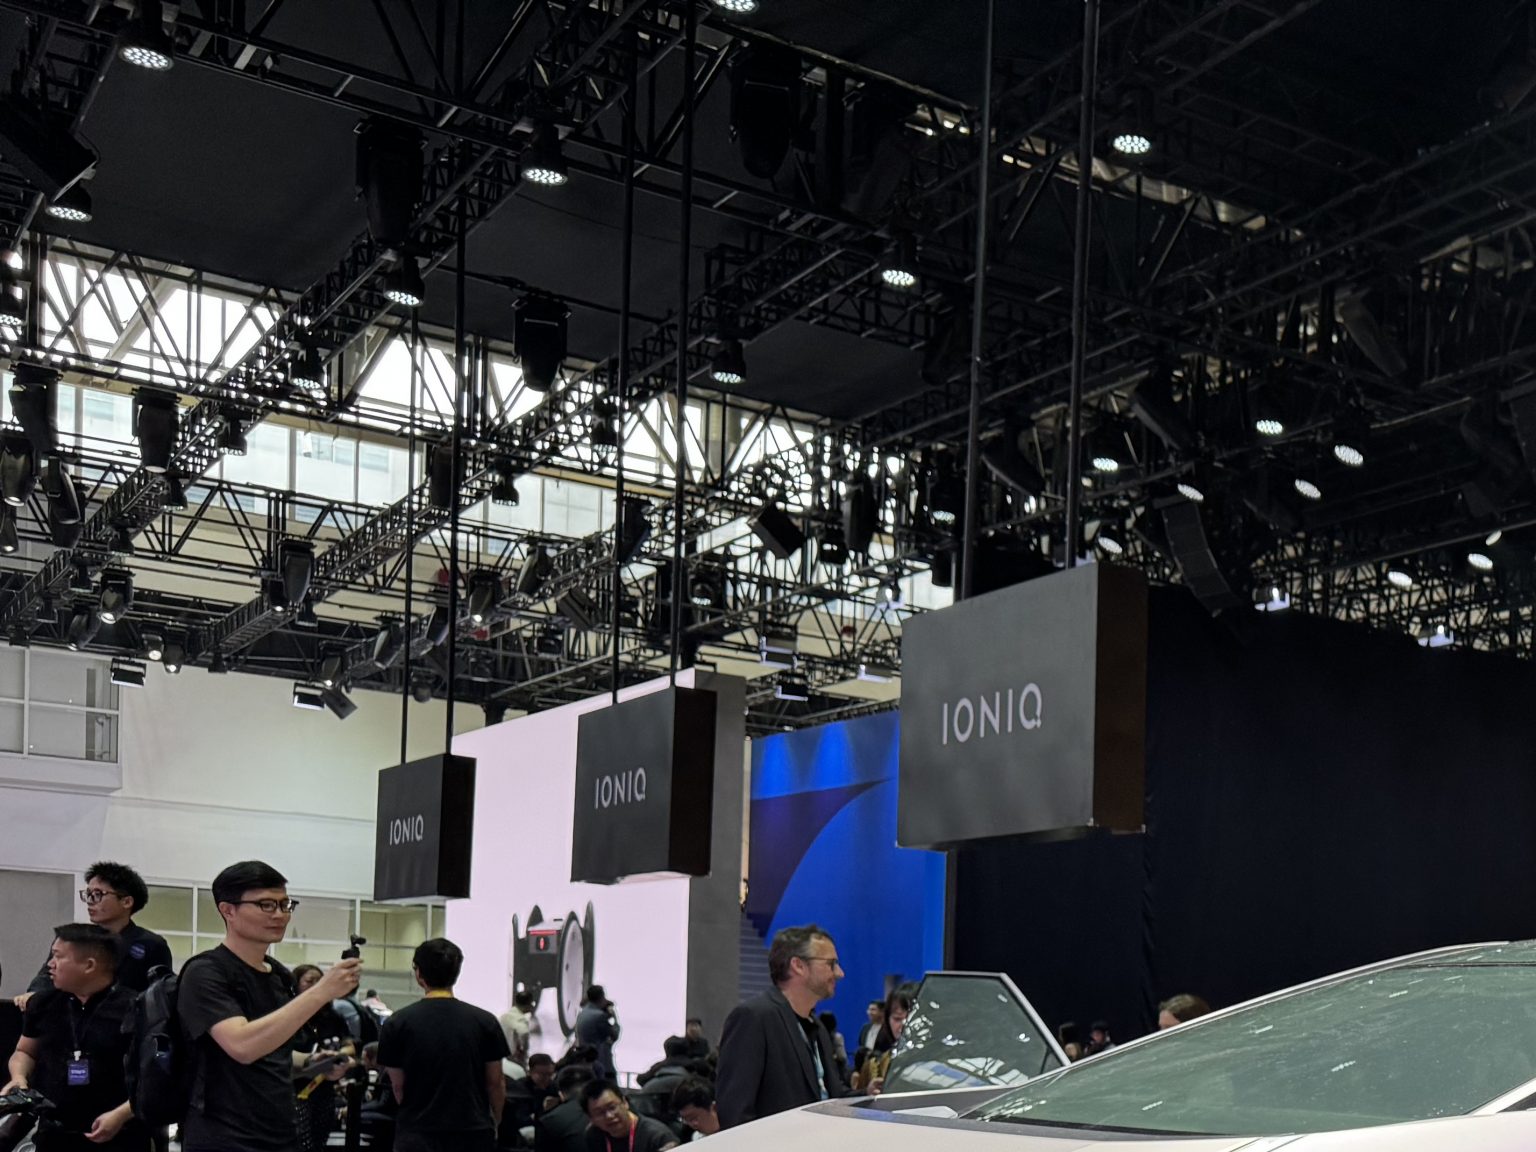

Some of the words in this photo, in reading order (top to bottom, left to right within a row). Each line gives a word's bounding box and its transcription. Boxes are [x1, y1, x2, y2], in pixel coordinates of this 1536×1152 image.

[942, 682, 1042, 745] IONIQ
[595, 767, 646, 809] IONIQ
[389, 814, 424, 845] IONIQ
